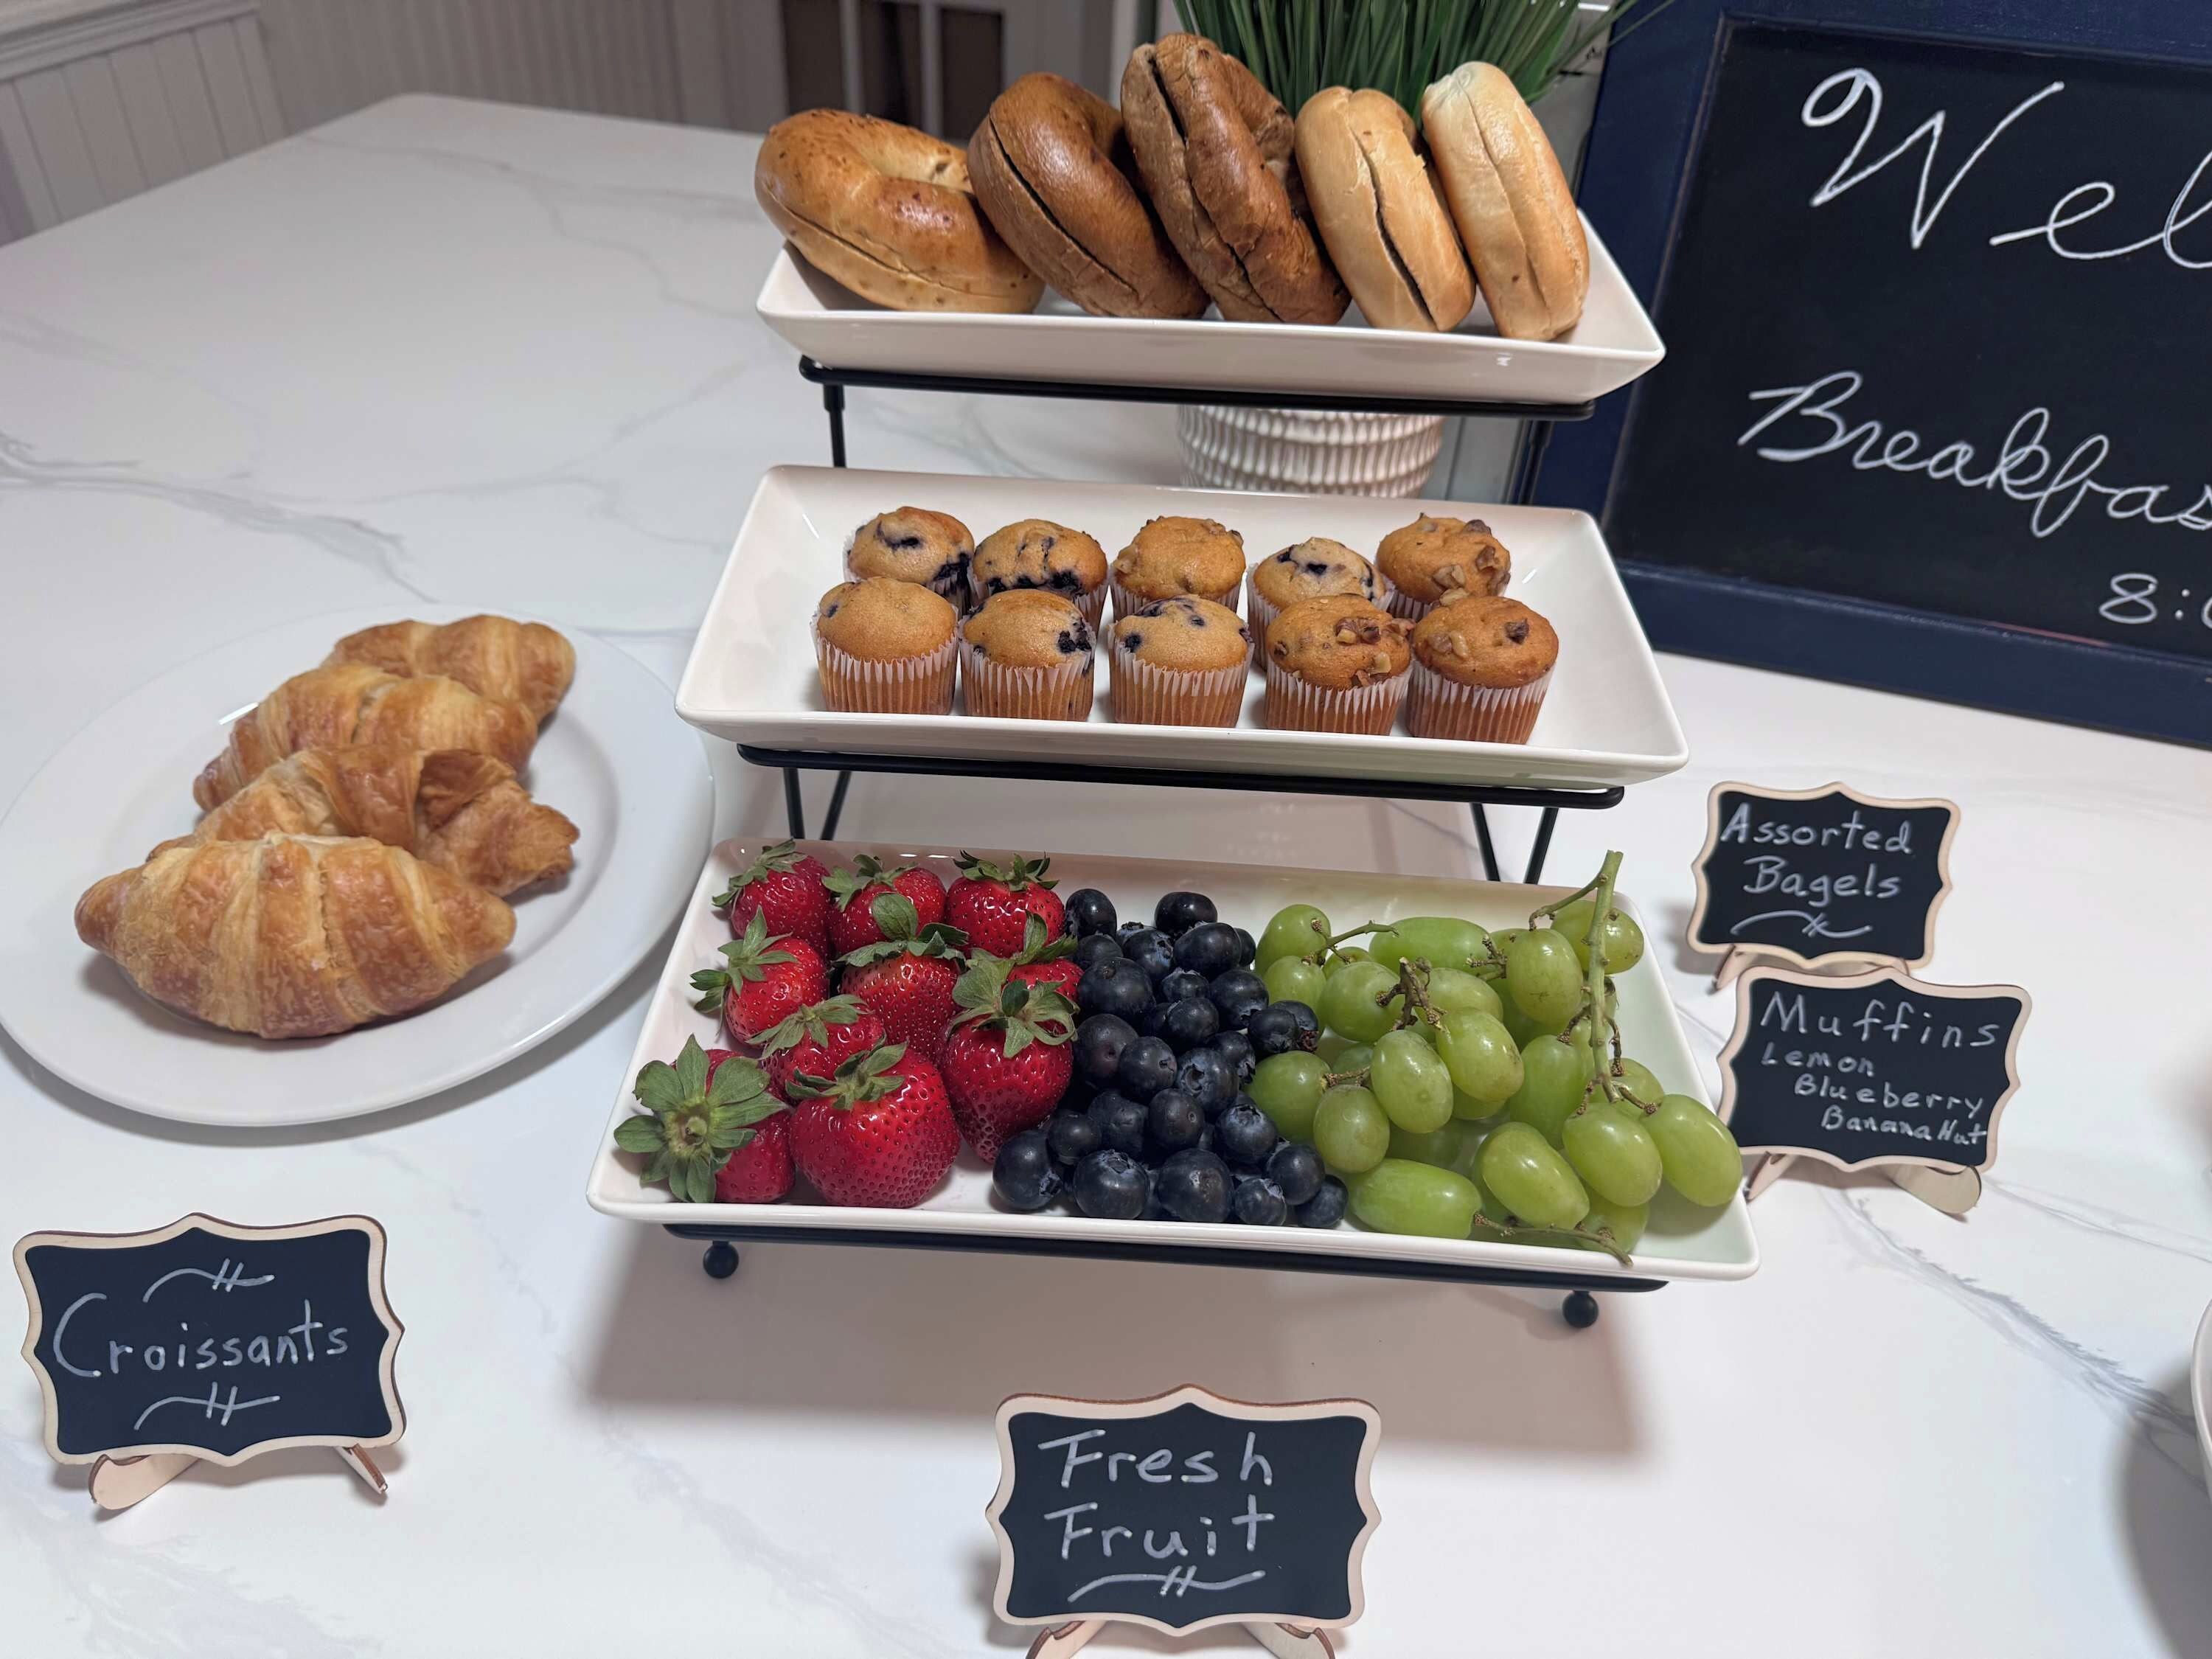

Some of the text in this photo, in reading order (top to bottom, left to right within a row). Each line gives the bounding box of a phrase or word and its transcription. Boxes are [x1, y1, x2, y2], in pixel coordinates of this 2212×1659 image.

[1721, 803, 1913, 854] Assorted
[1743, 855, 1901, 907] Bagels
[1761, 992, 1999, 1048] Muffins
[1761, 1042, 1874, 1077] Lemon
[1795, 1073, 1983, 1119] Blueberry
[52, 1293, 349, 1377] Croissants
[1038, 1430, 1272, 1488] Fresh
[1044, 1495, 1275, 1559] Fruit
